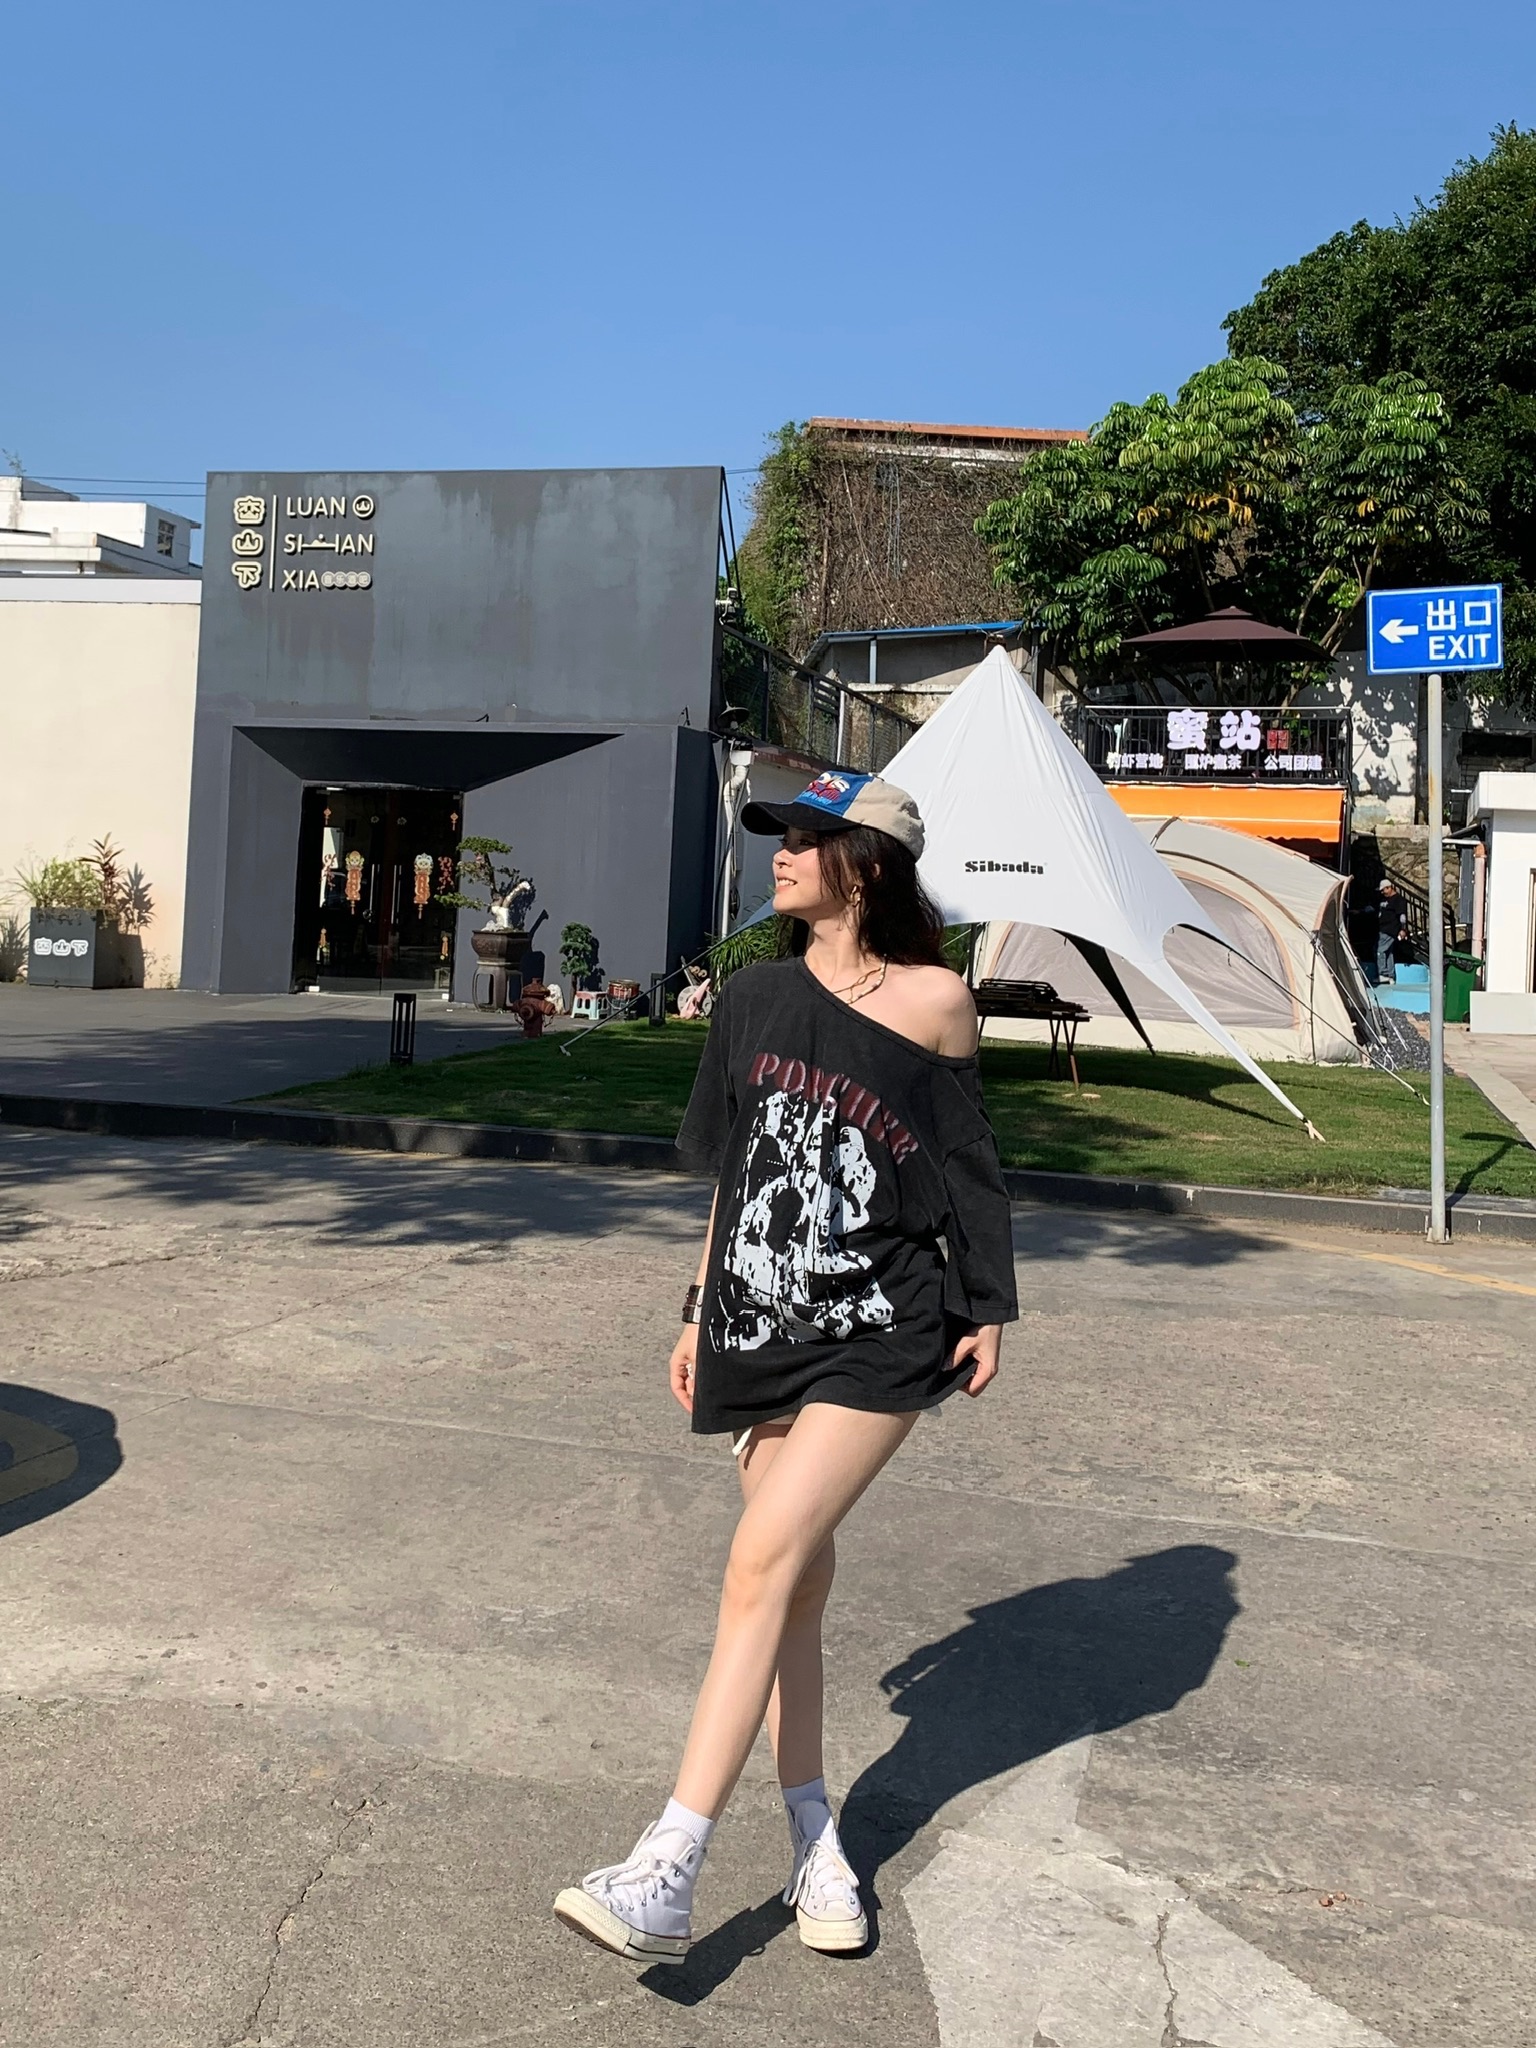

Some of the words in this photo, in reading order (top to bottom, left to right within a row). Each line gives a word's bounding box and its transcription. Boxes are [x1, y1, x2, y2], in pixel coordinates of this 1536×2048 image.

[286, 496, 346, 516] LUAN
[281, 569, 320, 589] XIA
[1426, 599, 1492, 631] 出口
[1428, 633, 1492, 660] EXIT
[1167, 708, 1261, 751] 蜜站
[1264, 753, 1323, 771] 公司团建
[964, 860, 1044, 875] Sibada
